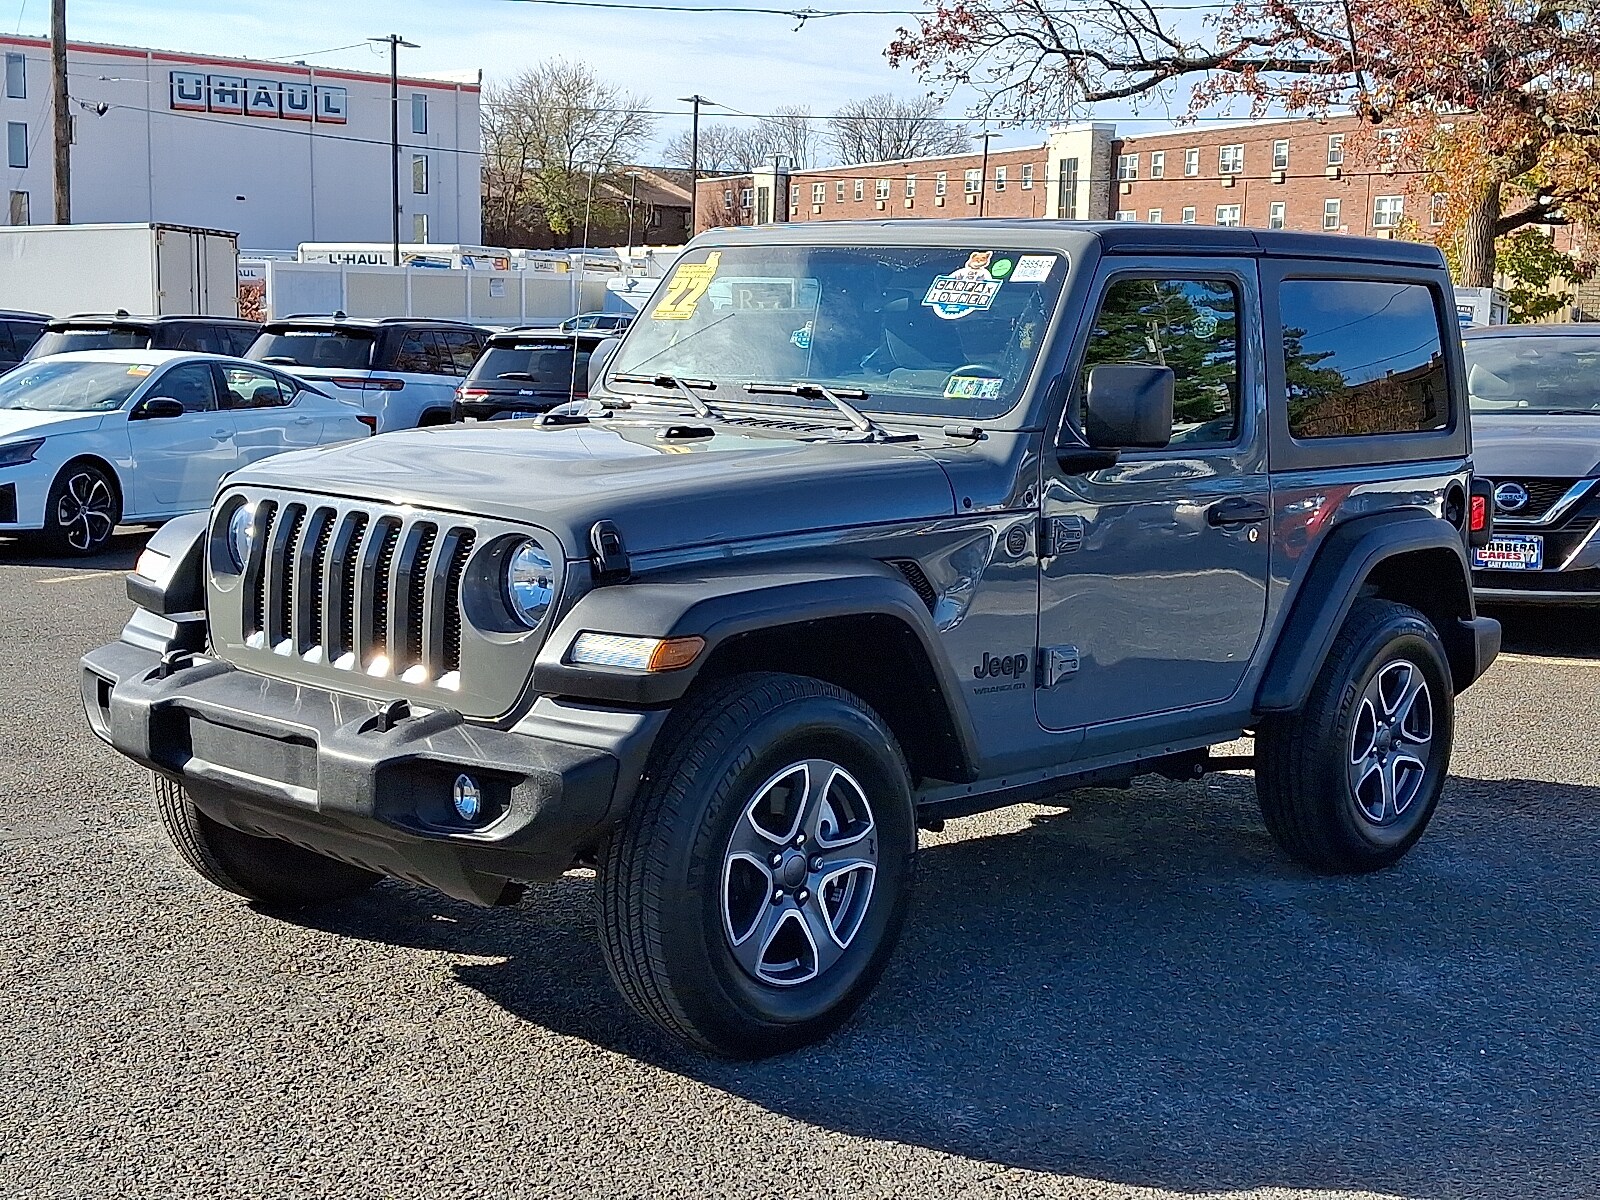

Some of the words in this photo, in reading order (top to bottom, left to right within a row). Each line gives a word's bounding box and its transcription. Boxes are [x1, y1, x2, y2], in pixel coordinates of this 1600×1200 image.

[935, 280, 994, 294] CARFAX
[518, 388, 534, 396] Jeep
[1479, 551, 1522, 560] CARES
[973, 651, 1028, 679] Jeep
